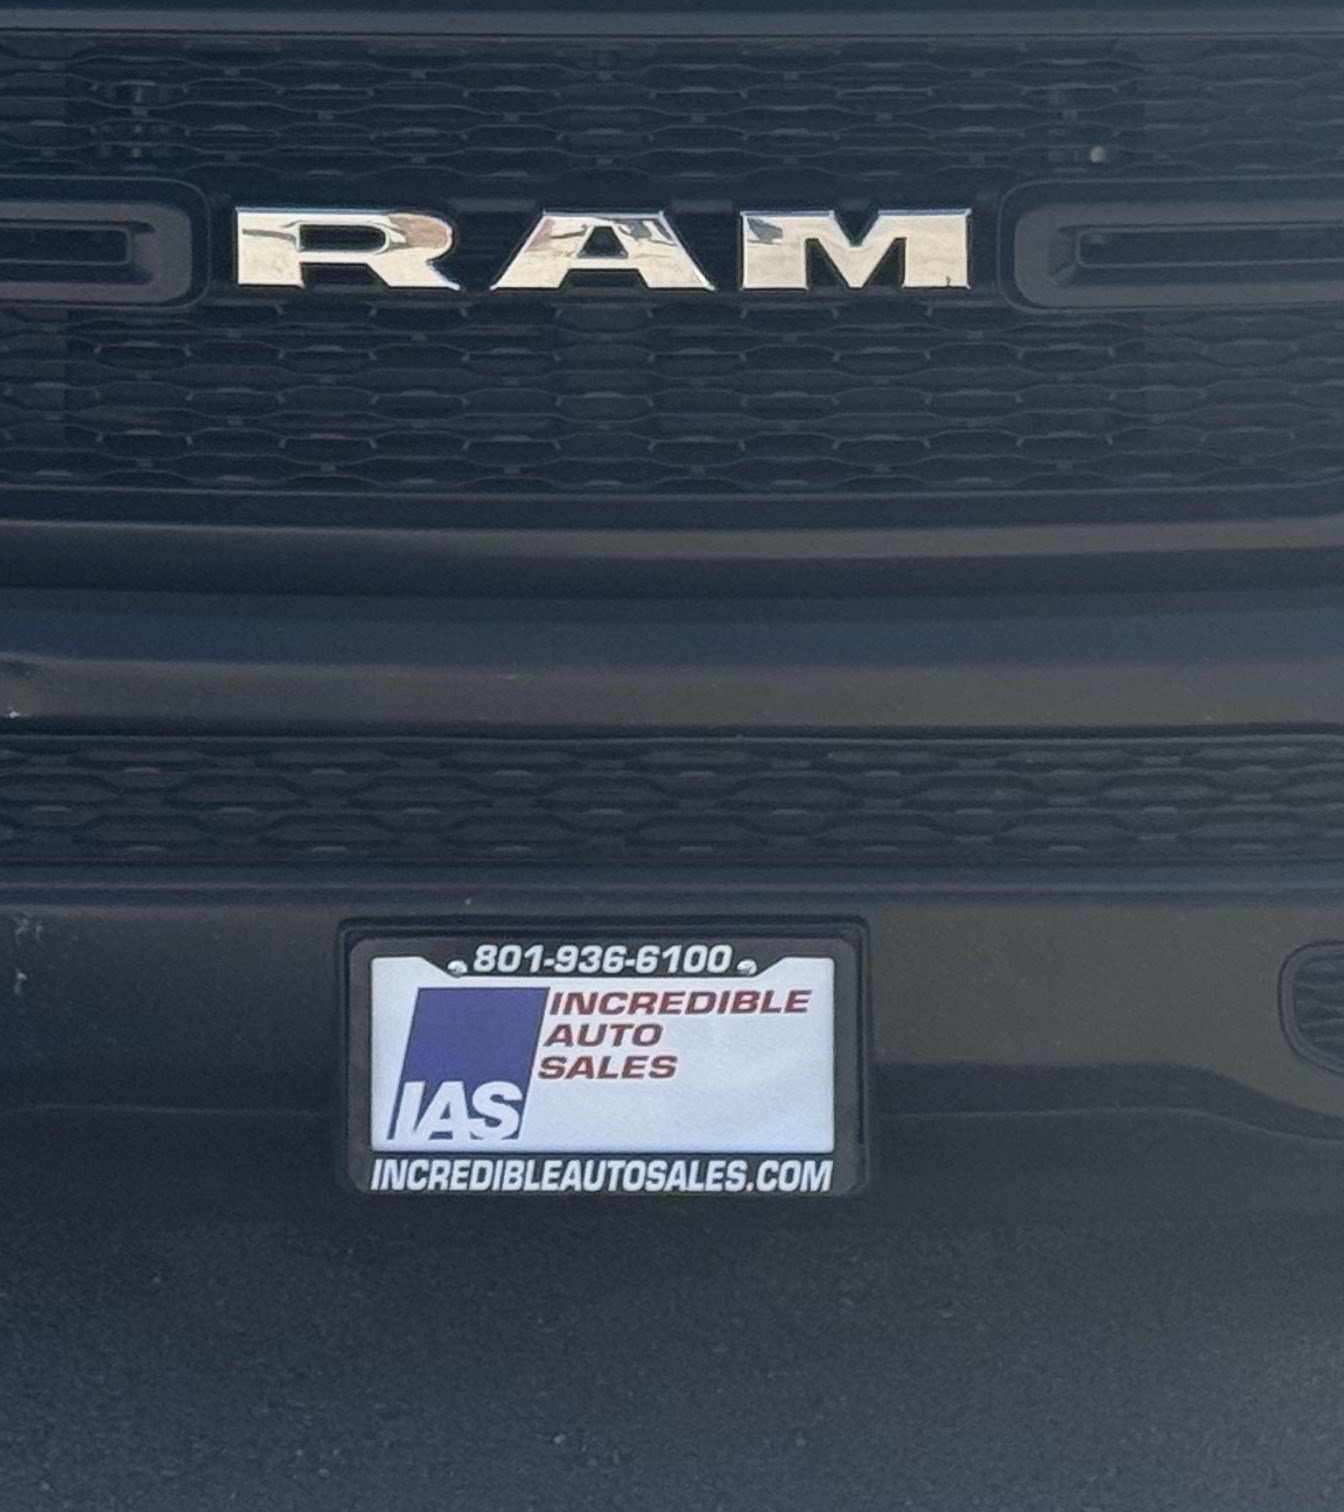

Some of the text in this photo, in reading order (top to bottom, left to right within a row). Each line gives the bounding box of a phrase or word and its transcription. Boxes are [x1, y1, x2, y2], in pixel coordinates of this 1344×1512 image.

[234, 207, 972, 290] RAM
[473, 944, 733, 974] 801-936-6100
[549, 989, 813, 1016] INCREDIBLE
[543, 1022, 664, 1047] AUTO
[537, 1055, 679, 1080] SALES
[392, 1080, 524, 1141] IAS
[370, 1158, 834, 1193] INCREDIBLEAUTOSALES.COM
